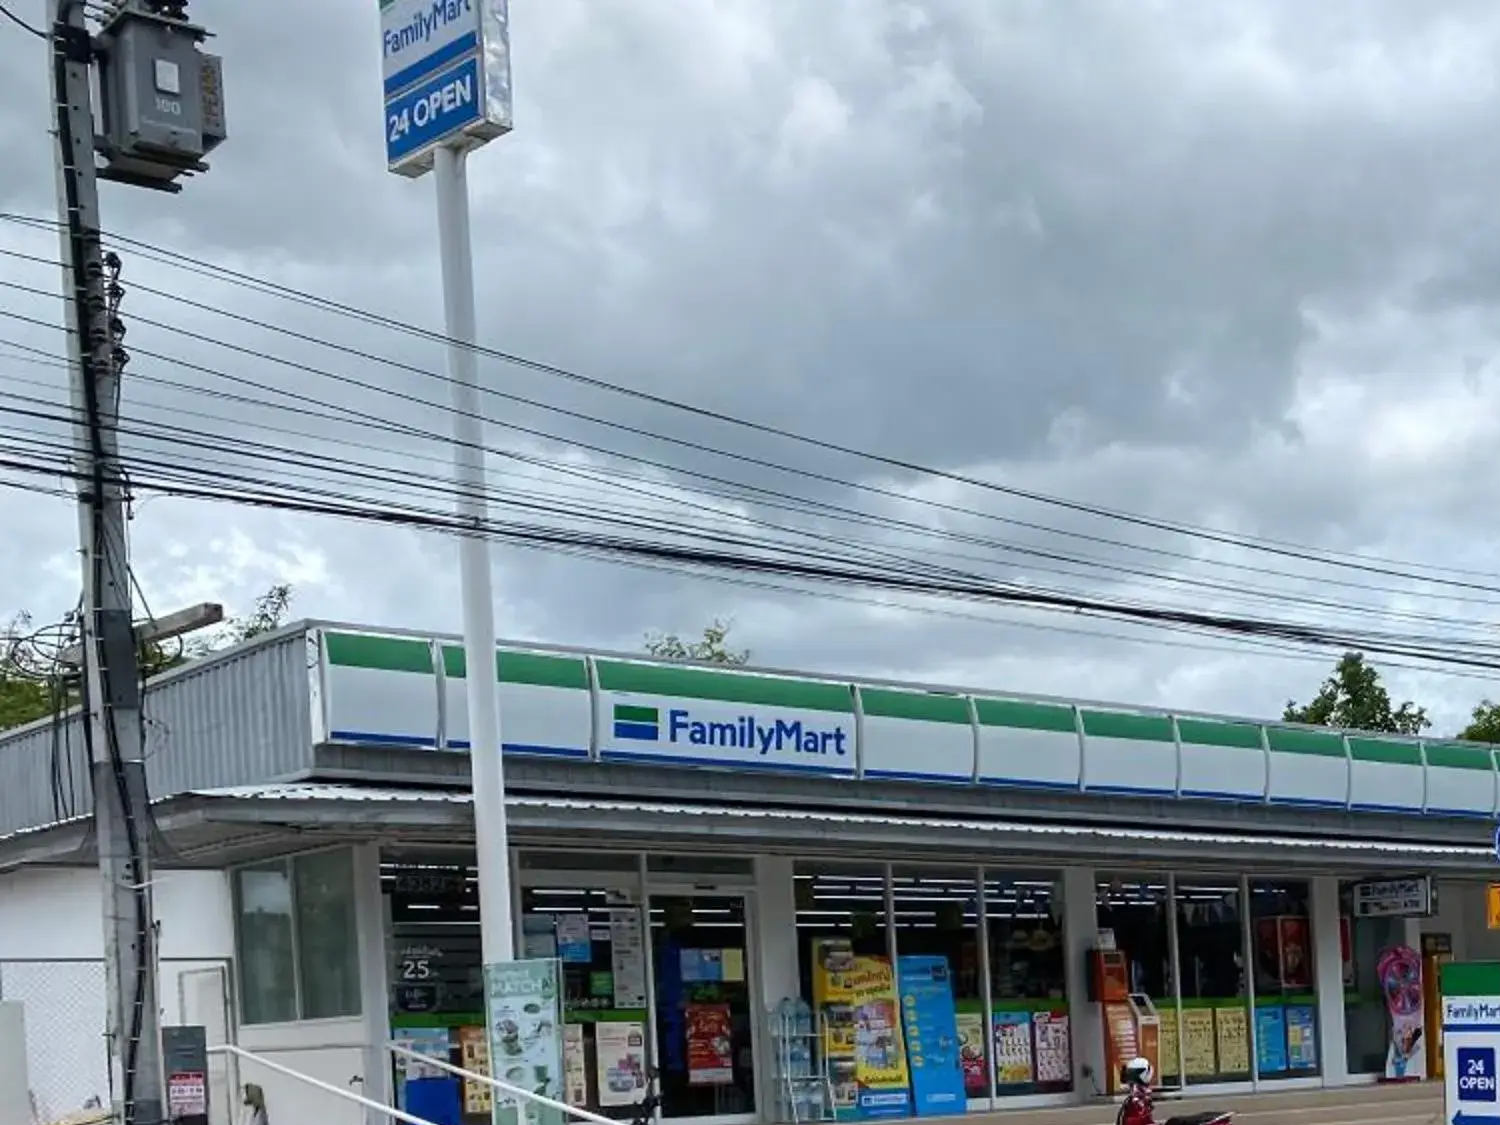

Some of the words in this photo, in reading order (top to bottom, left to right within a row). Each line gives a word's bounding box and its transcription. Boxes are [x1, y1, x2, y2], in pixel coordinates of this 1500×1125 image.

[389, 108, 410, 142] 24
[413, 74, 472, 127] OPEN
[669, 709, 846, 755] FamilyMart
[403, 959, 429, 979] 25
[1467, 1059, 1485, 1075] 24
[1459, 1076, 1495, 1090] OPEN
